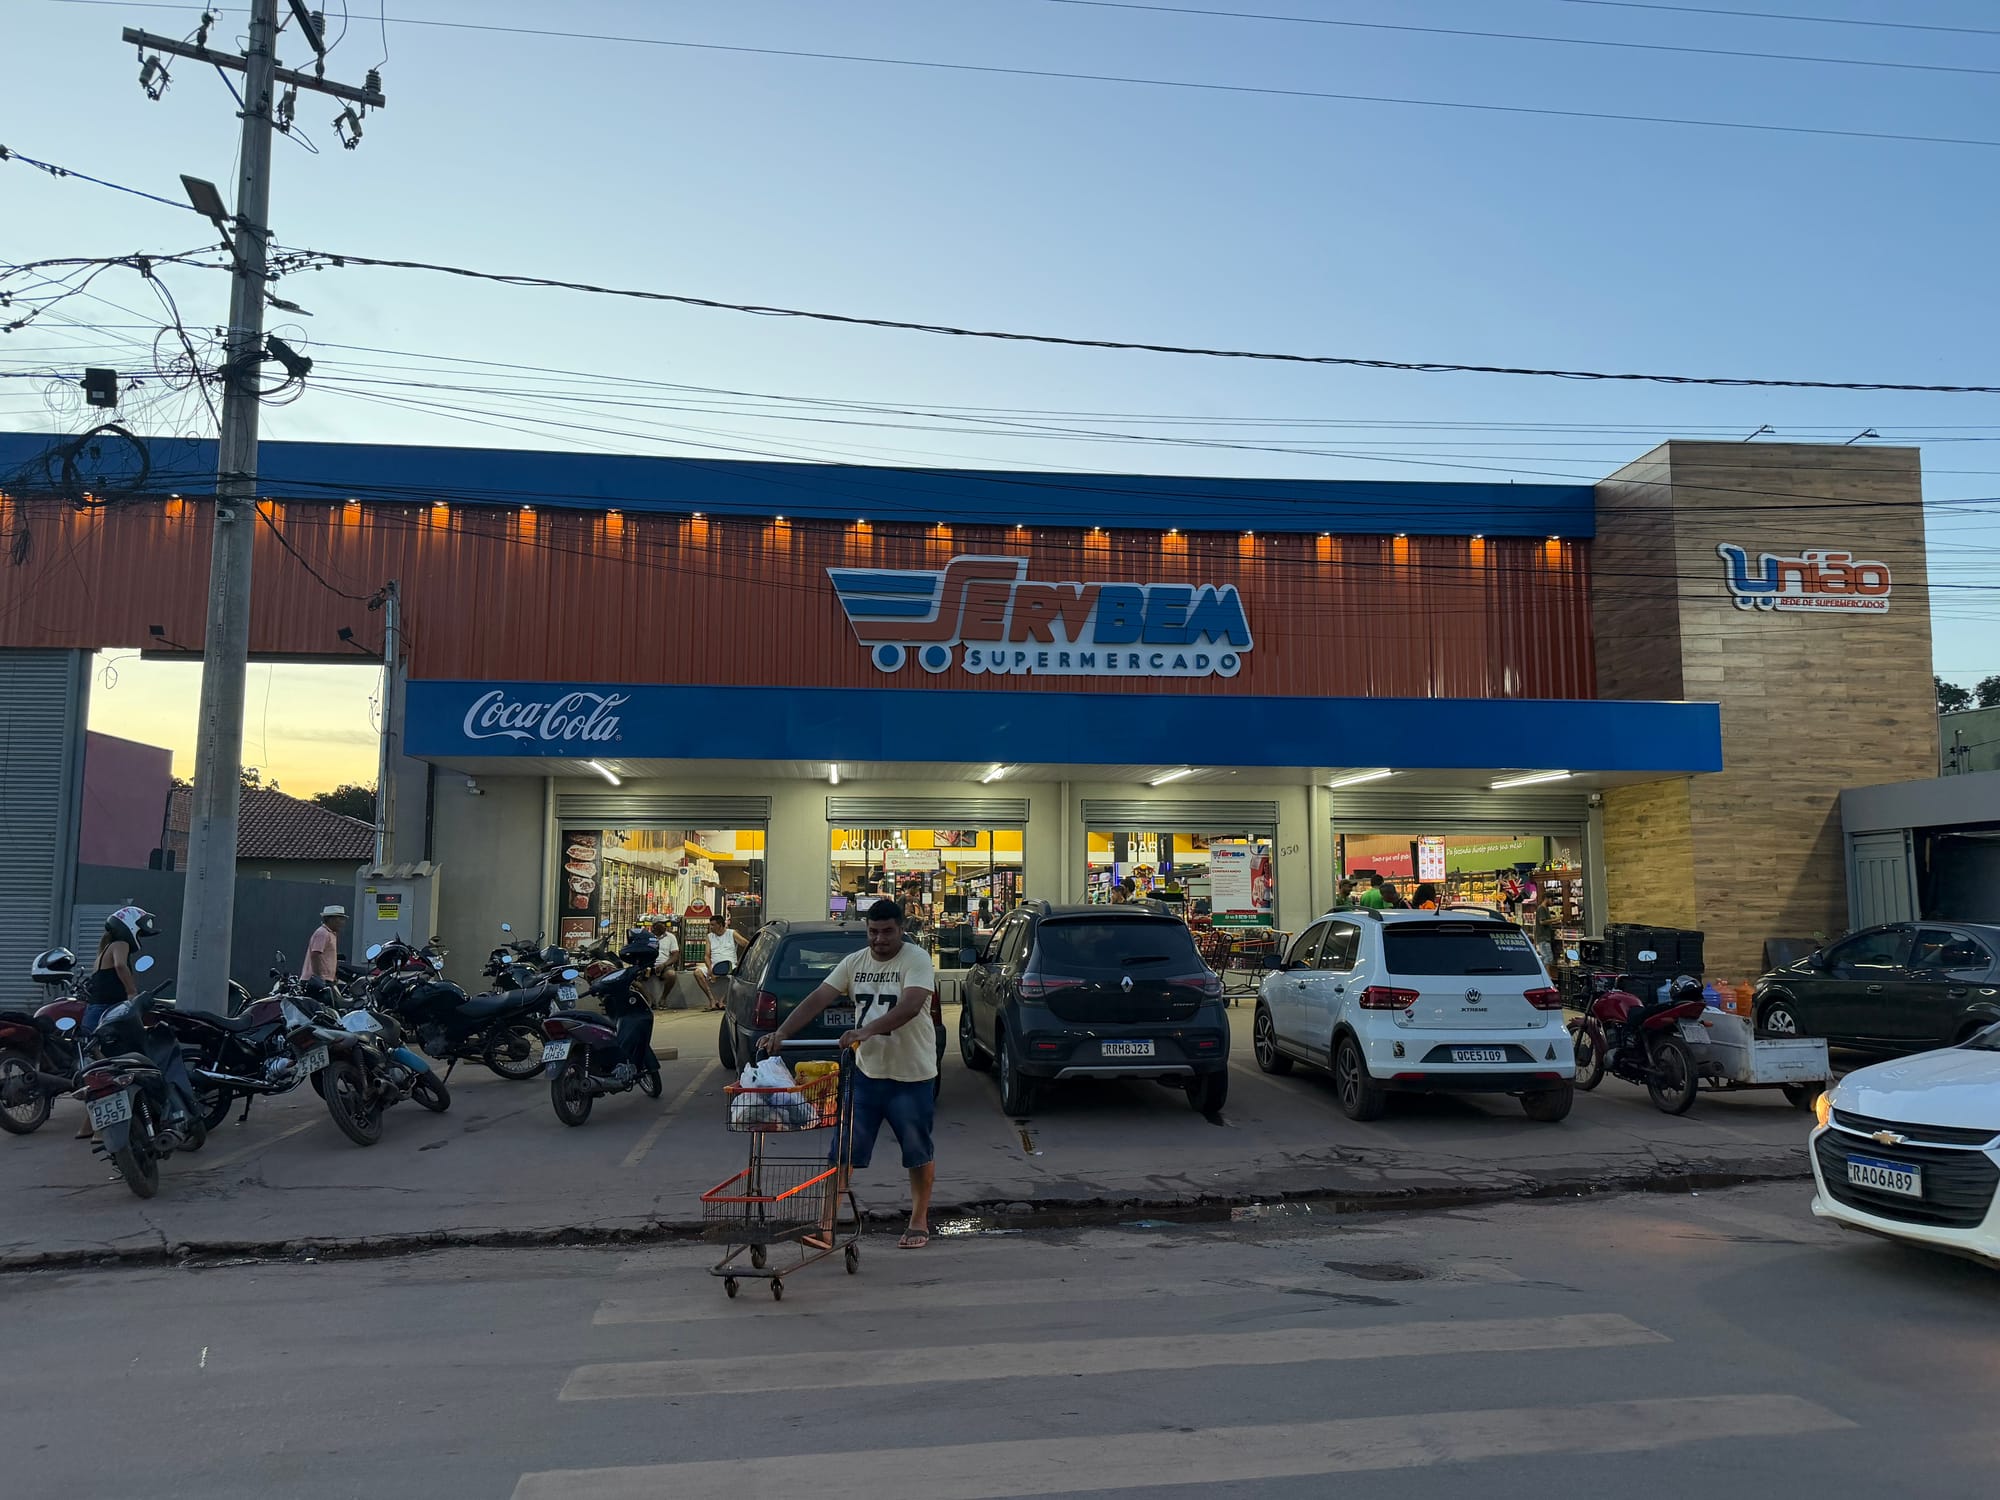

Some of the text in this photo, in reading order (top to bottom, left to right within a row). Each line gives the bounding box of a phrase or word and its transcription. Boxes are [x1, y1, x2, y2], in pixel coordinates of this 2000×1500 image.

[1722, 546, 1890, 596] União
[853, 558, 1250, 645] SERVBEM
[1780, 598, 1885, 609] REDE DE SUPERMERCADOS
[970, 649, 1237, 670] SUPERMERCADO
[463, 690, 631, 741] Coca-Cola
[854, 971, 901, 983] BROOKLYN
[95, 1108, 126, 1128] 5297
